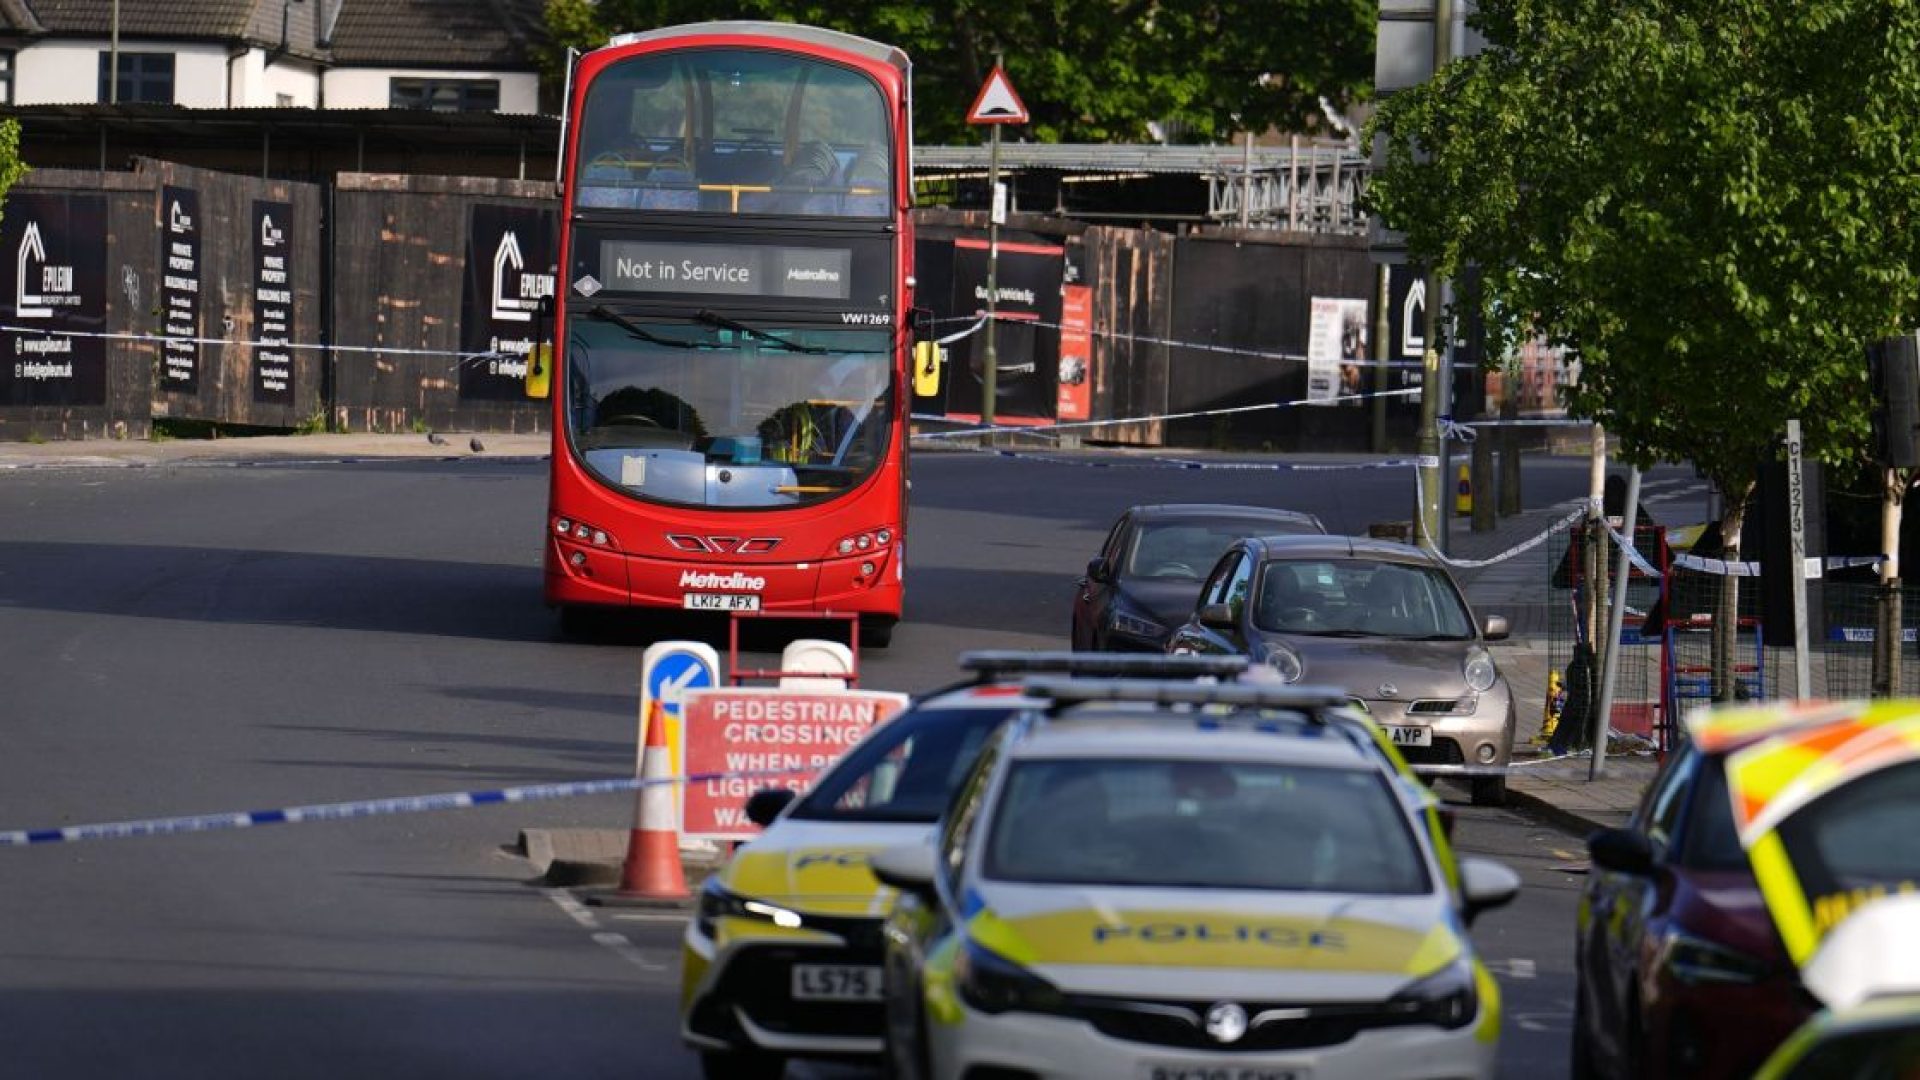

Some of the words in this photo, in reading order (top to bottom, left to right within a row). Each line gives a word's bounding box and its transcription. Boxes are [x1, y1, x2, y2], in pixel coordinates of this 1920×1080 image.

[615, 257, 652, 280] Not
[658, 260, 675, 280] in
[680, 259, 750, 283] Service
[786, 267, 840, 282] Metroline
[841, 313, 890, 326] VW1269
[679, 570, 766, 591] Metroline
[690, 593, 723, 609] LK12
[728, 594, 753, 610] AFX
[712, 699, 875, 723] PEDESTRIAN
[724, 723, 863, 745] CROSSING
[1393, 728, 1423, 743] AYP
[726, 751, 801, 771] WHEN
[1093, 923, 1346, 949] POLICE
[800, 968, 867, 997] LS75
